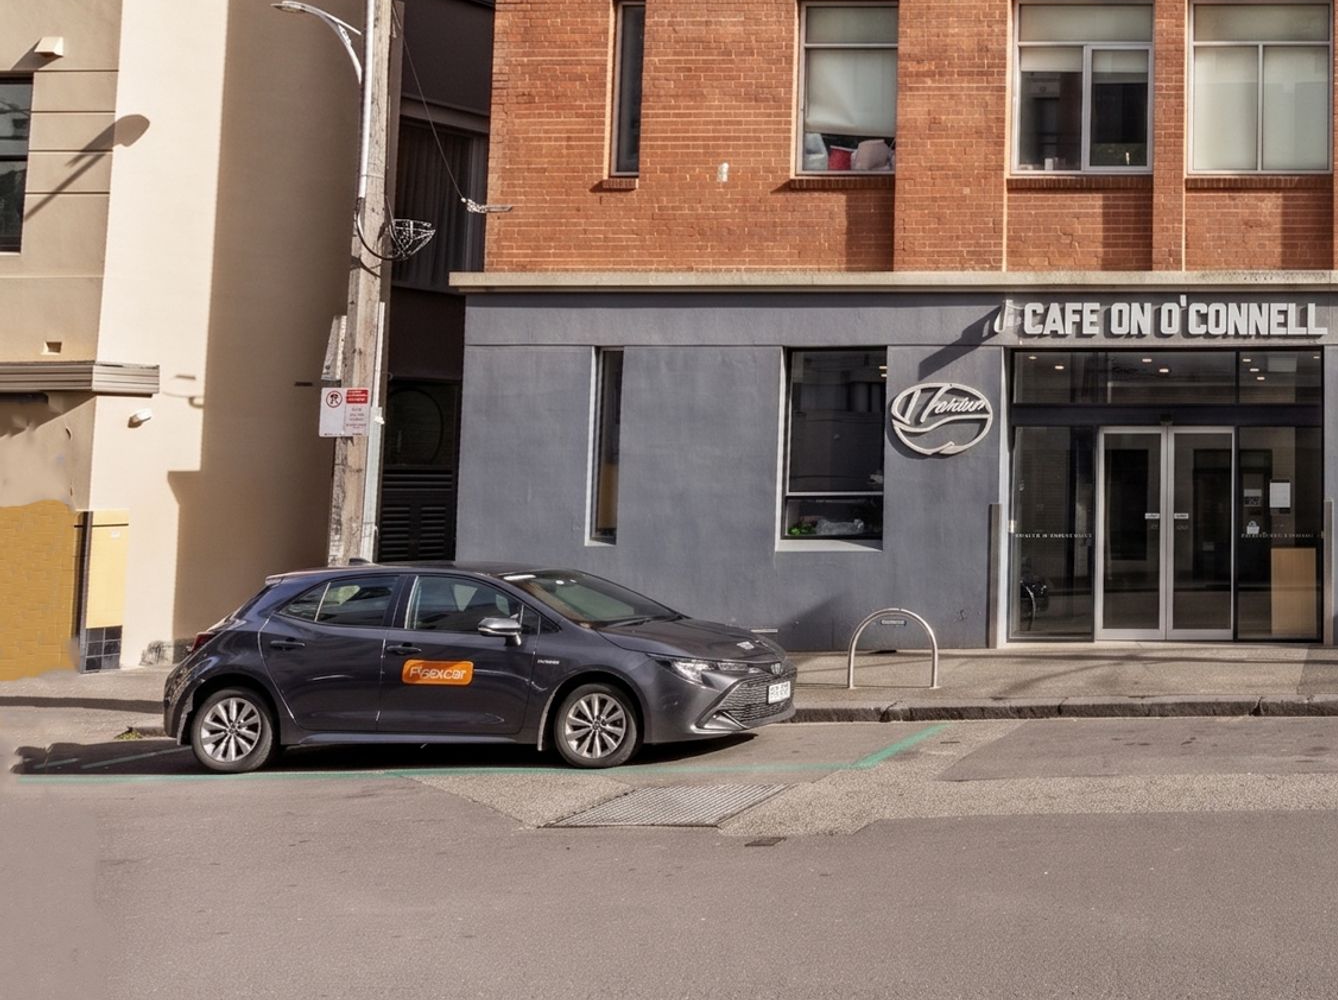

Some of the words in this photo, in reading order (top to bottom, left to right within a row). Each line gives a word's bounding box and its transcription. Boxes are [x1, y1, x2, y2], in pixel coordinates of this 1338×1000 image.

[1024, 302, 1099, 335] CAFE
[1110, 302, 1151, 335] ON
[1160, 295, 1328, 335] O'CONNELL
